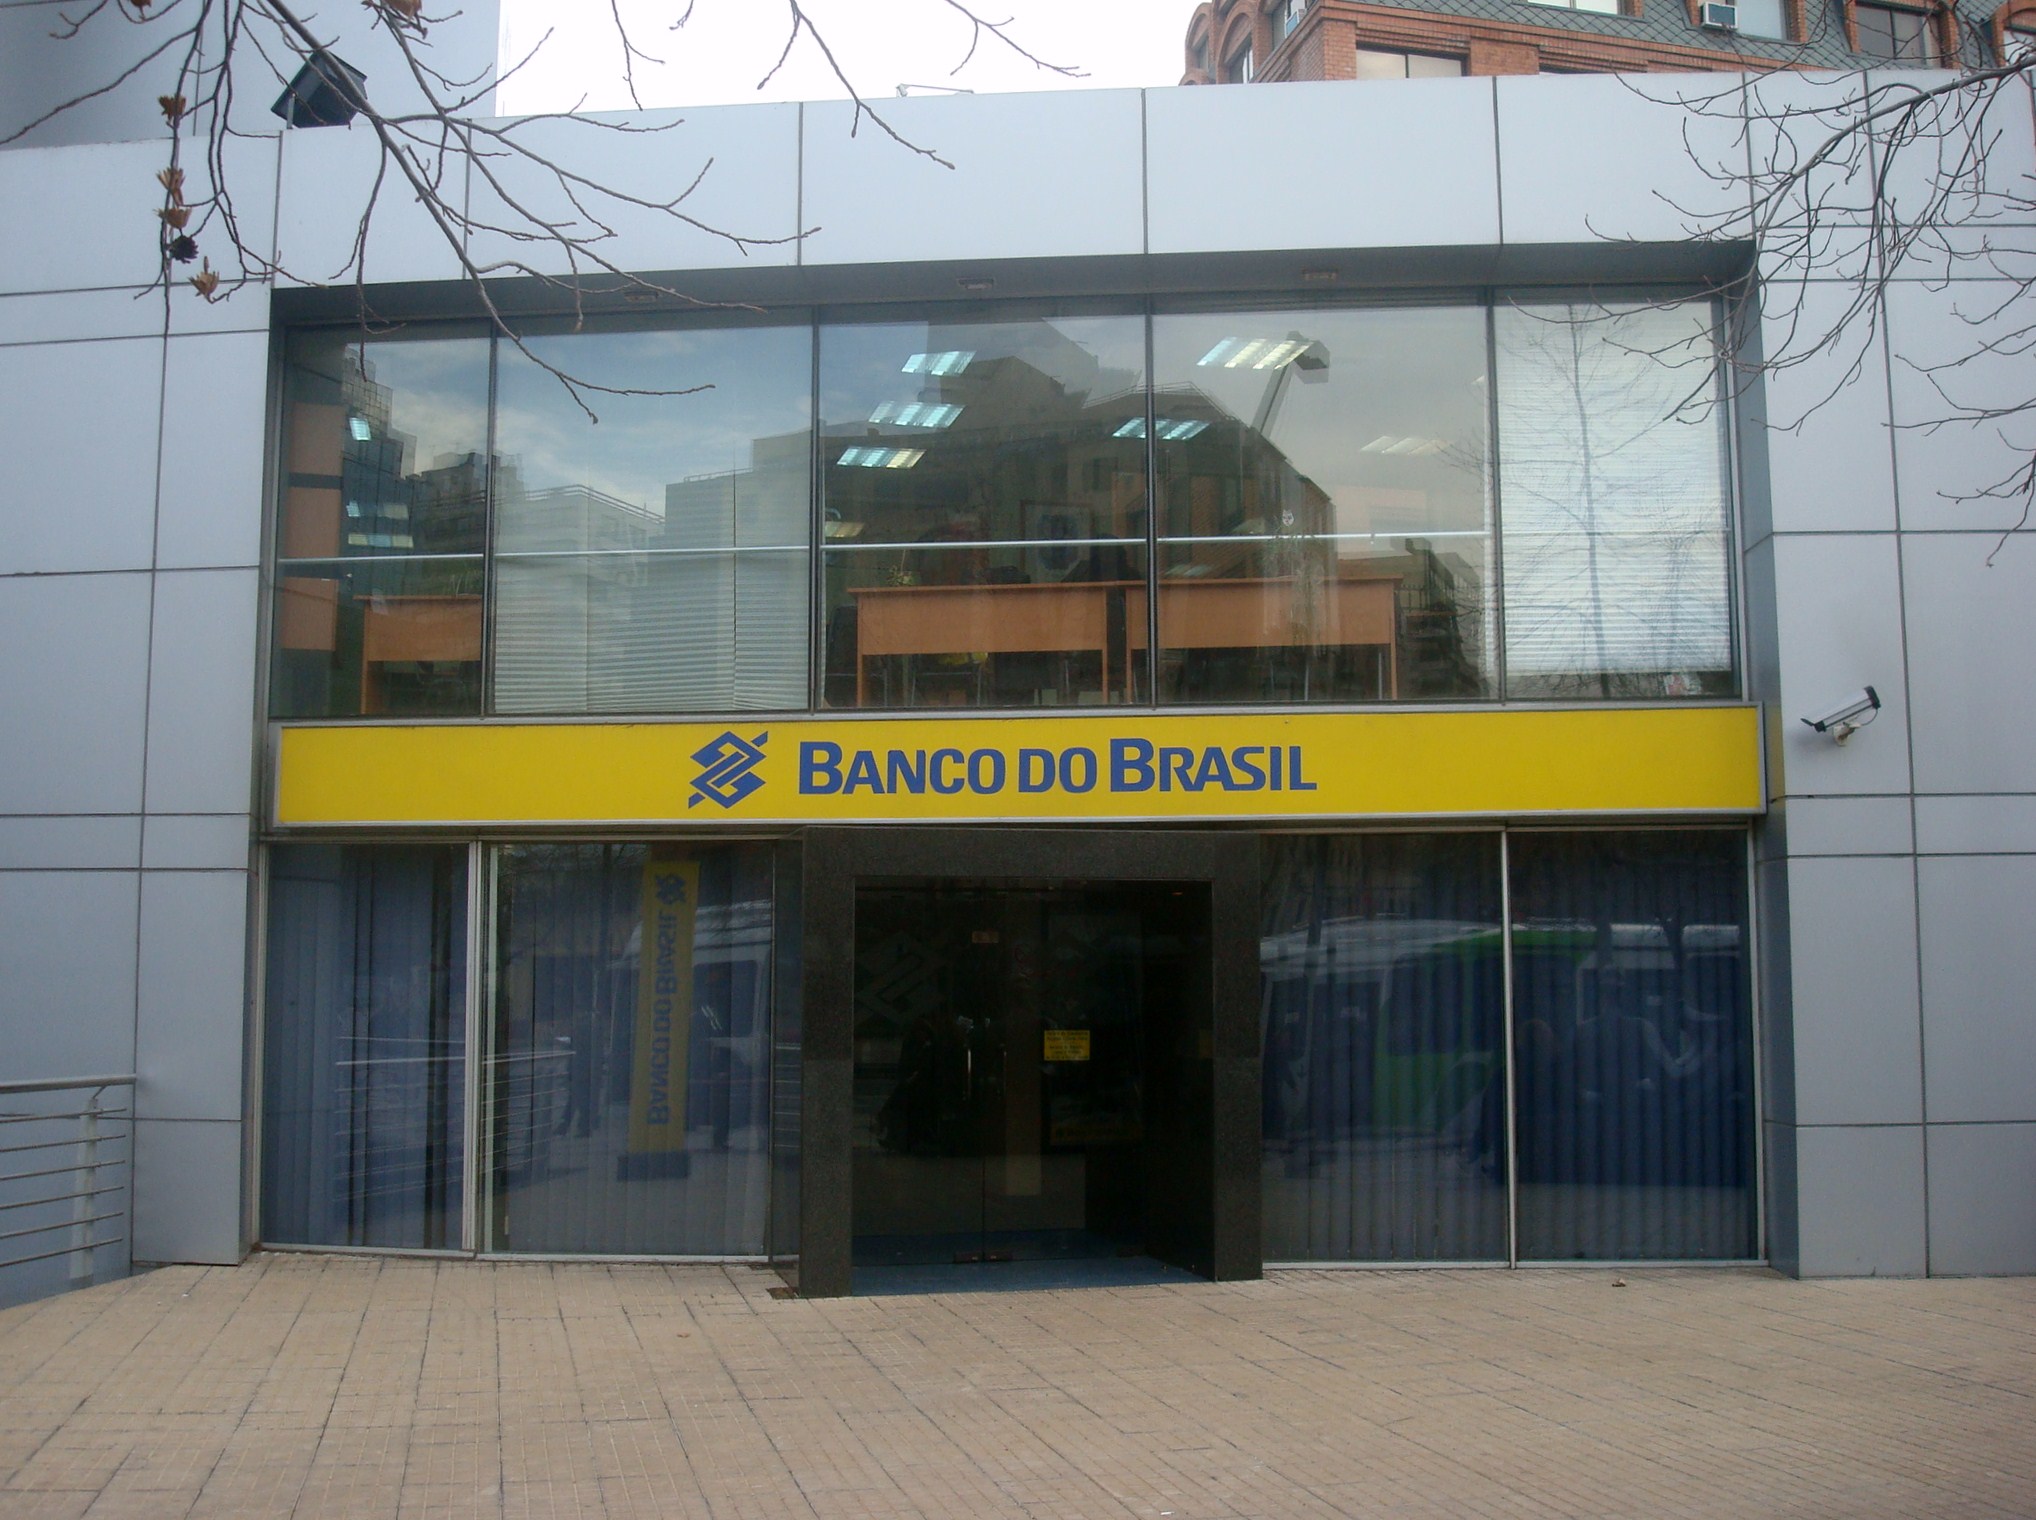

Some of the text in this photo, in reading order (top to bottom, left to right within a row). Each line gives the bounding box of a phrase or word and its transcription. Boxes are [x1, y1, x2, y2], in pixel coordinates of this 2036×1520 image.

[799, 738, 1317, 794] BANCO DO BRASIL
